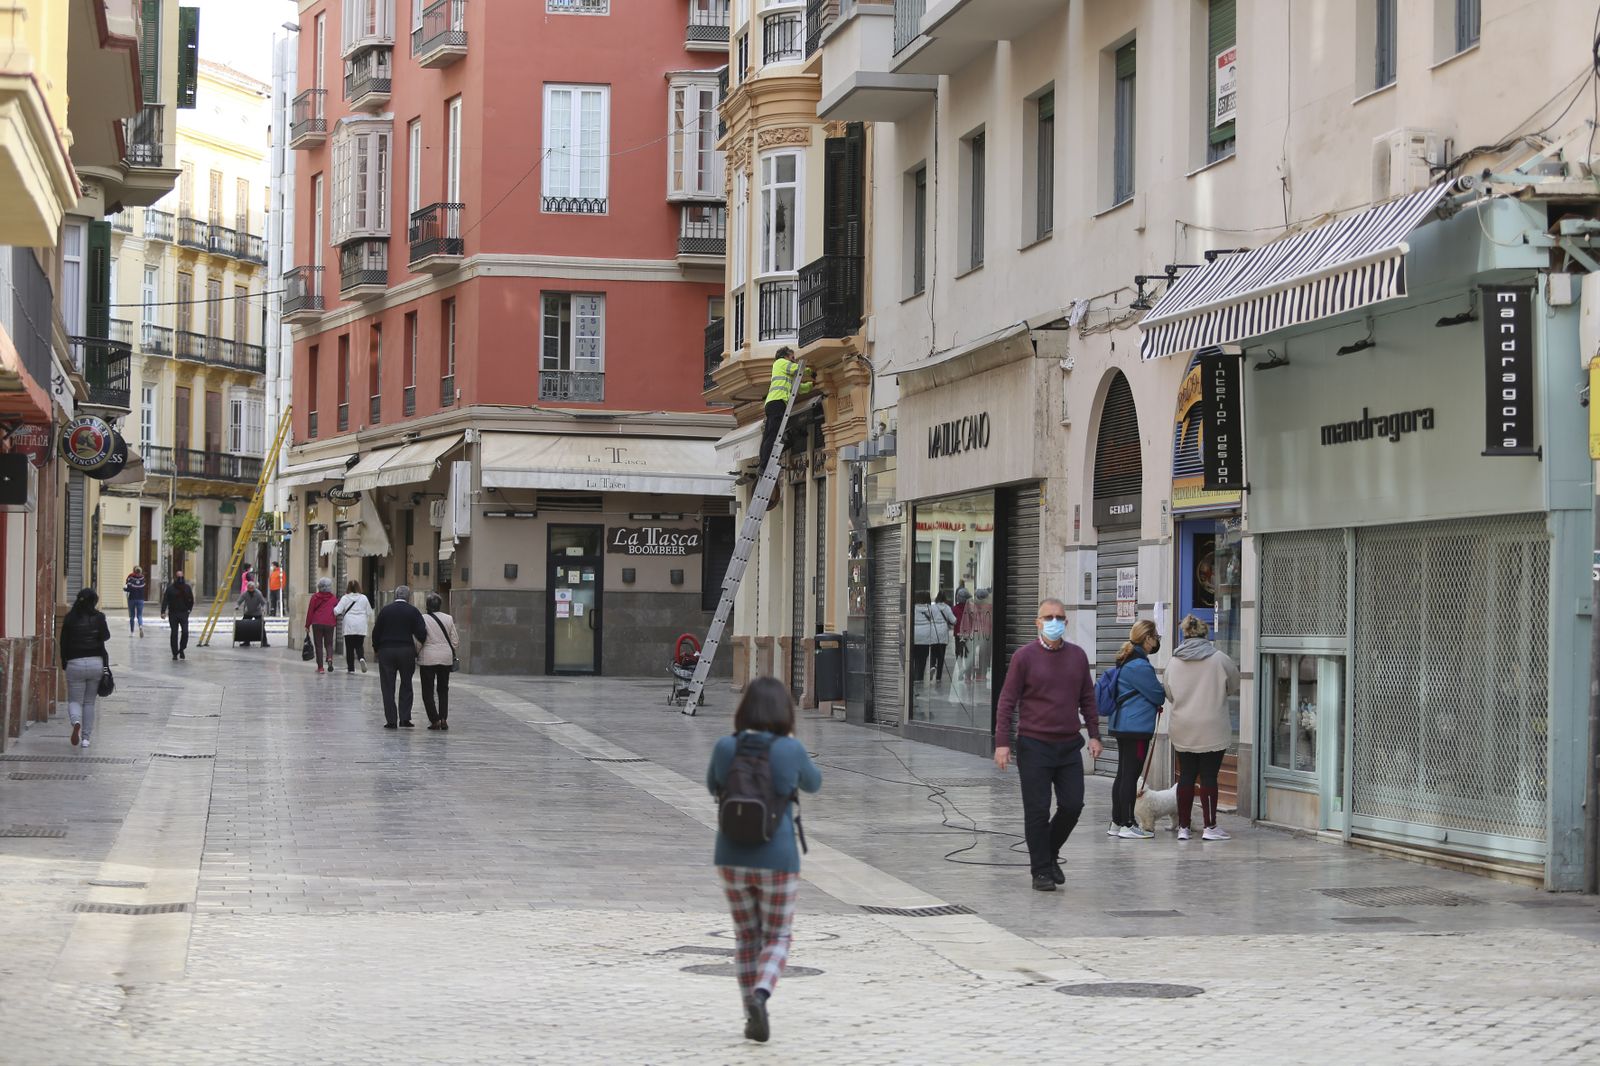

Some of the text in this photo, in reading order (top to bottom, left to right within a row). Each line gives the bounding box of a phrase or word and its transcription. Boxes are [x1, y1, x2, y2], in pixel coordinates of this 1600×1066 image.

[1496, 292, 1518, 449] mandragora
[63, 418, 110, 439] PAULANER
[961, 411, 991, 453] CANO
[1215, 361, 1229, 485] interior design
[1320, 407, 1435, 446] mandragora
[586, 446, 647, 466] La Tasca
[586, 477, 627, 490] La Tasca
[613, 527, 699, 547] La Tasca
[628, 545, 686, 556] BOOMBEER
